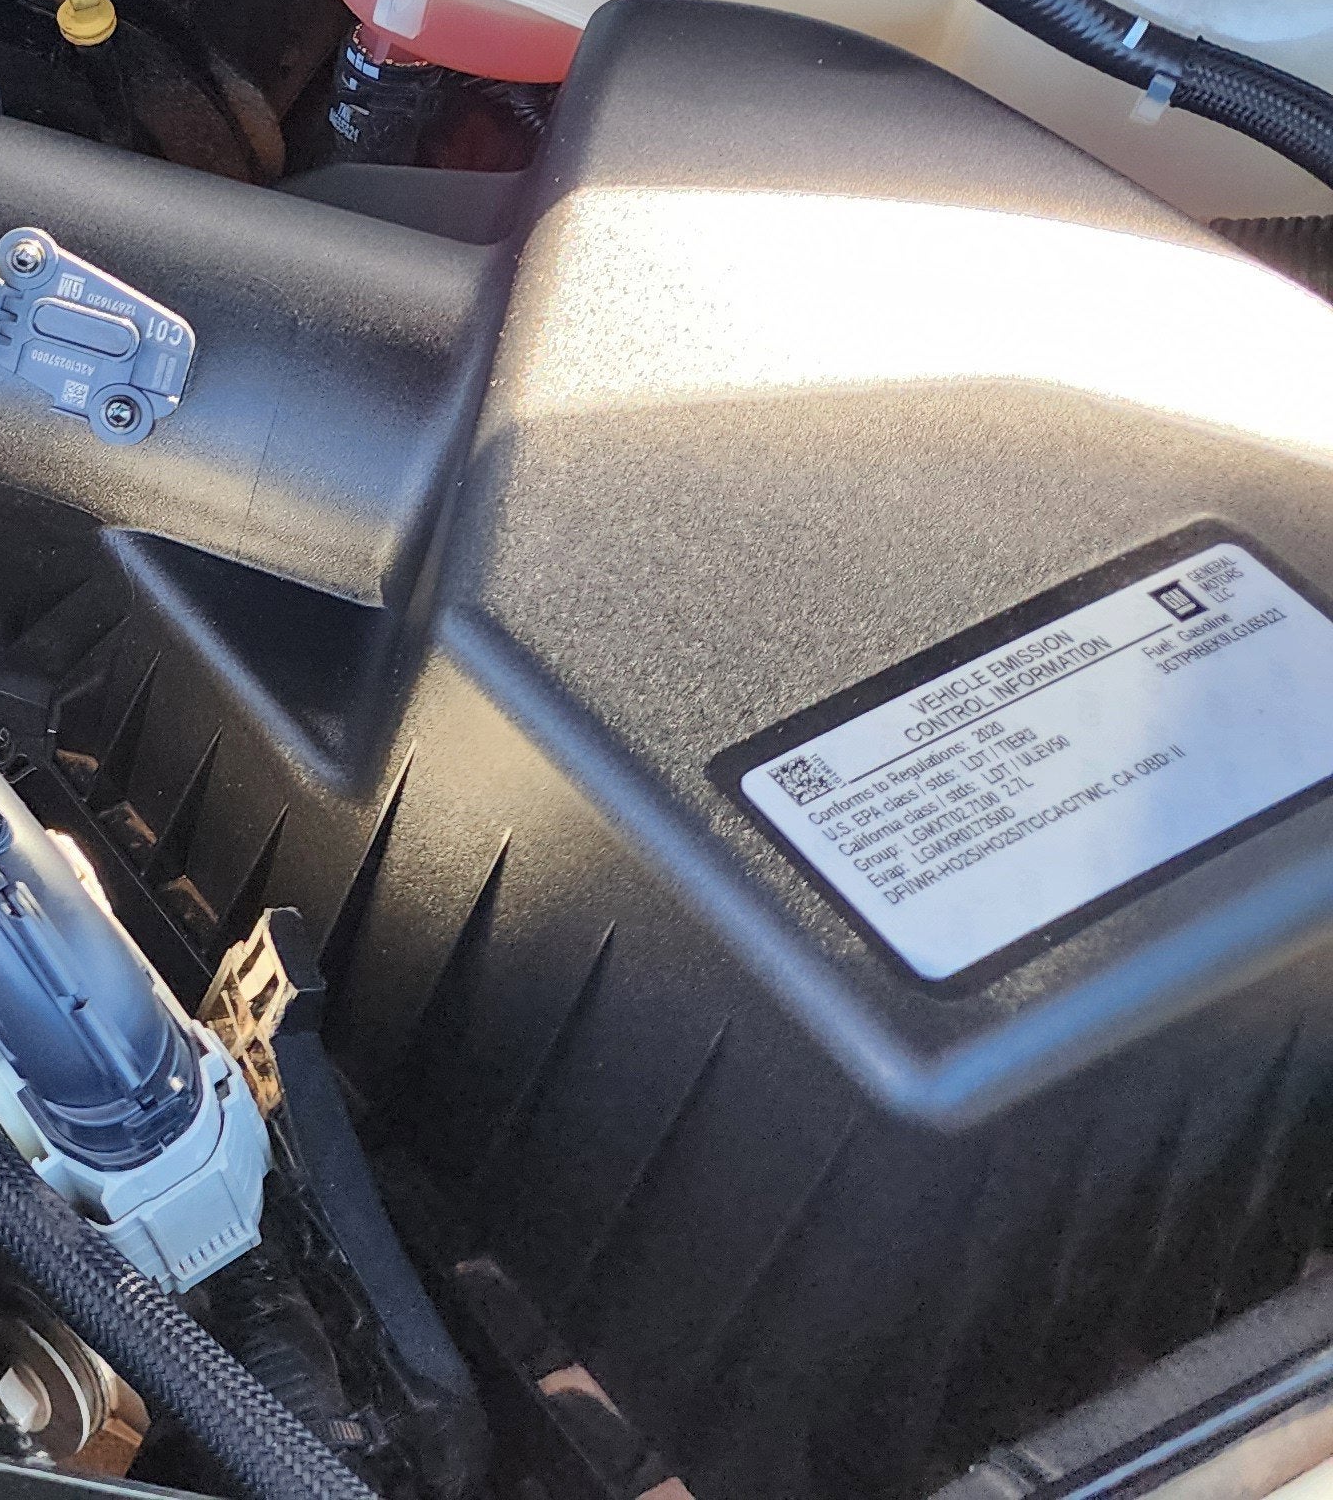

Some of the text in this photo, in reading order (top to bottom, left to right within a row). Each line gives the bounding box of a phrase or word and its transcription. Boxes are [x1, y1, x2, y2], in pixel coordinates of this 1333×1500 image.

[56, 275, 84, 301] GM
[145, 316, 184, 347] C01
[1185, 555, 1238, 583] GENERAL
[1198, 569, 1245, 593] MOTORS
[1209, 589, 1236, 605] LLC
[1141, 611, 1232, 661] Fuel: Gasoline
[903, 634, 1113, 744] CONTROL INFORMATION
[908, 628, 1074, 716] VEHICLE EMISSION
[808, 721, 1006, 826] Conforms to Regulations: 2020
[1111, 769, 1140, 788] CA
[1134, 751, 1174, 776] OBD:
[821, 821, 854, 843] U.S.
[850, 804, 883, 828] EPA
[883, 788, 920, 814] class
[926, 767, 963, 793] stds:
[959, 747, 992, 772] LDT
[837, 818, 904, 858] California
[903, 801, 941, 828] class
[948, 780, 983, 806] stds:
[983, 761, 1014, 786] LDT
[1015, 733, 1071, 767] ULEV50
[853, 842, 906, 874] Group:
[1000, 776, 1035, 799] 2.7L
[867, 860, 911, 890] Evap:
